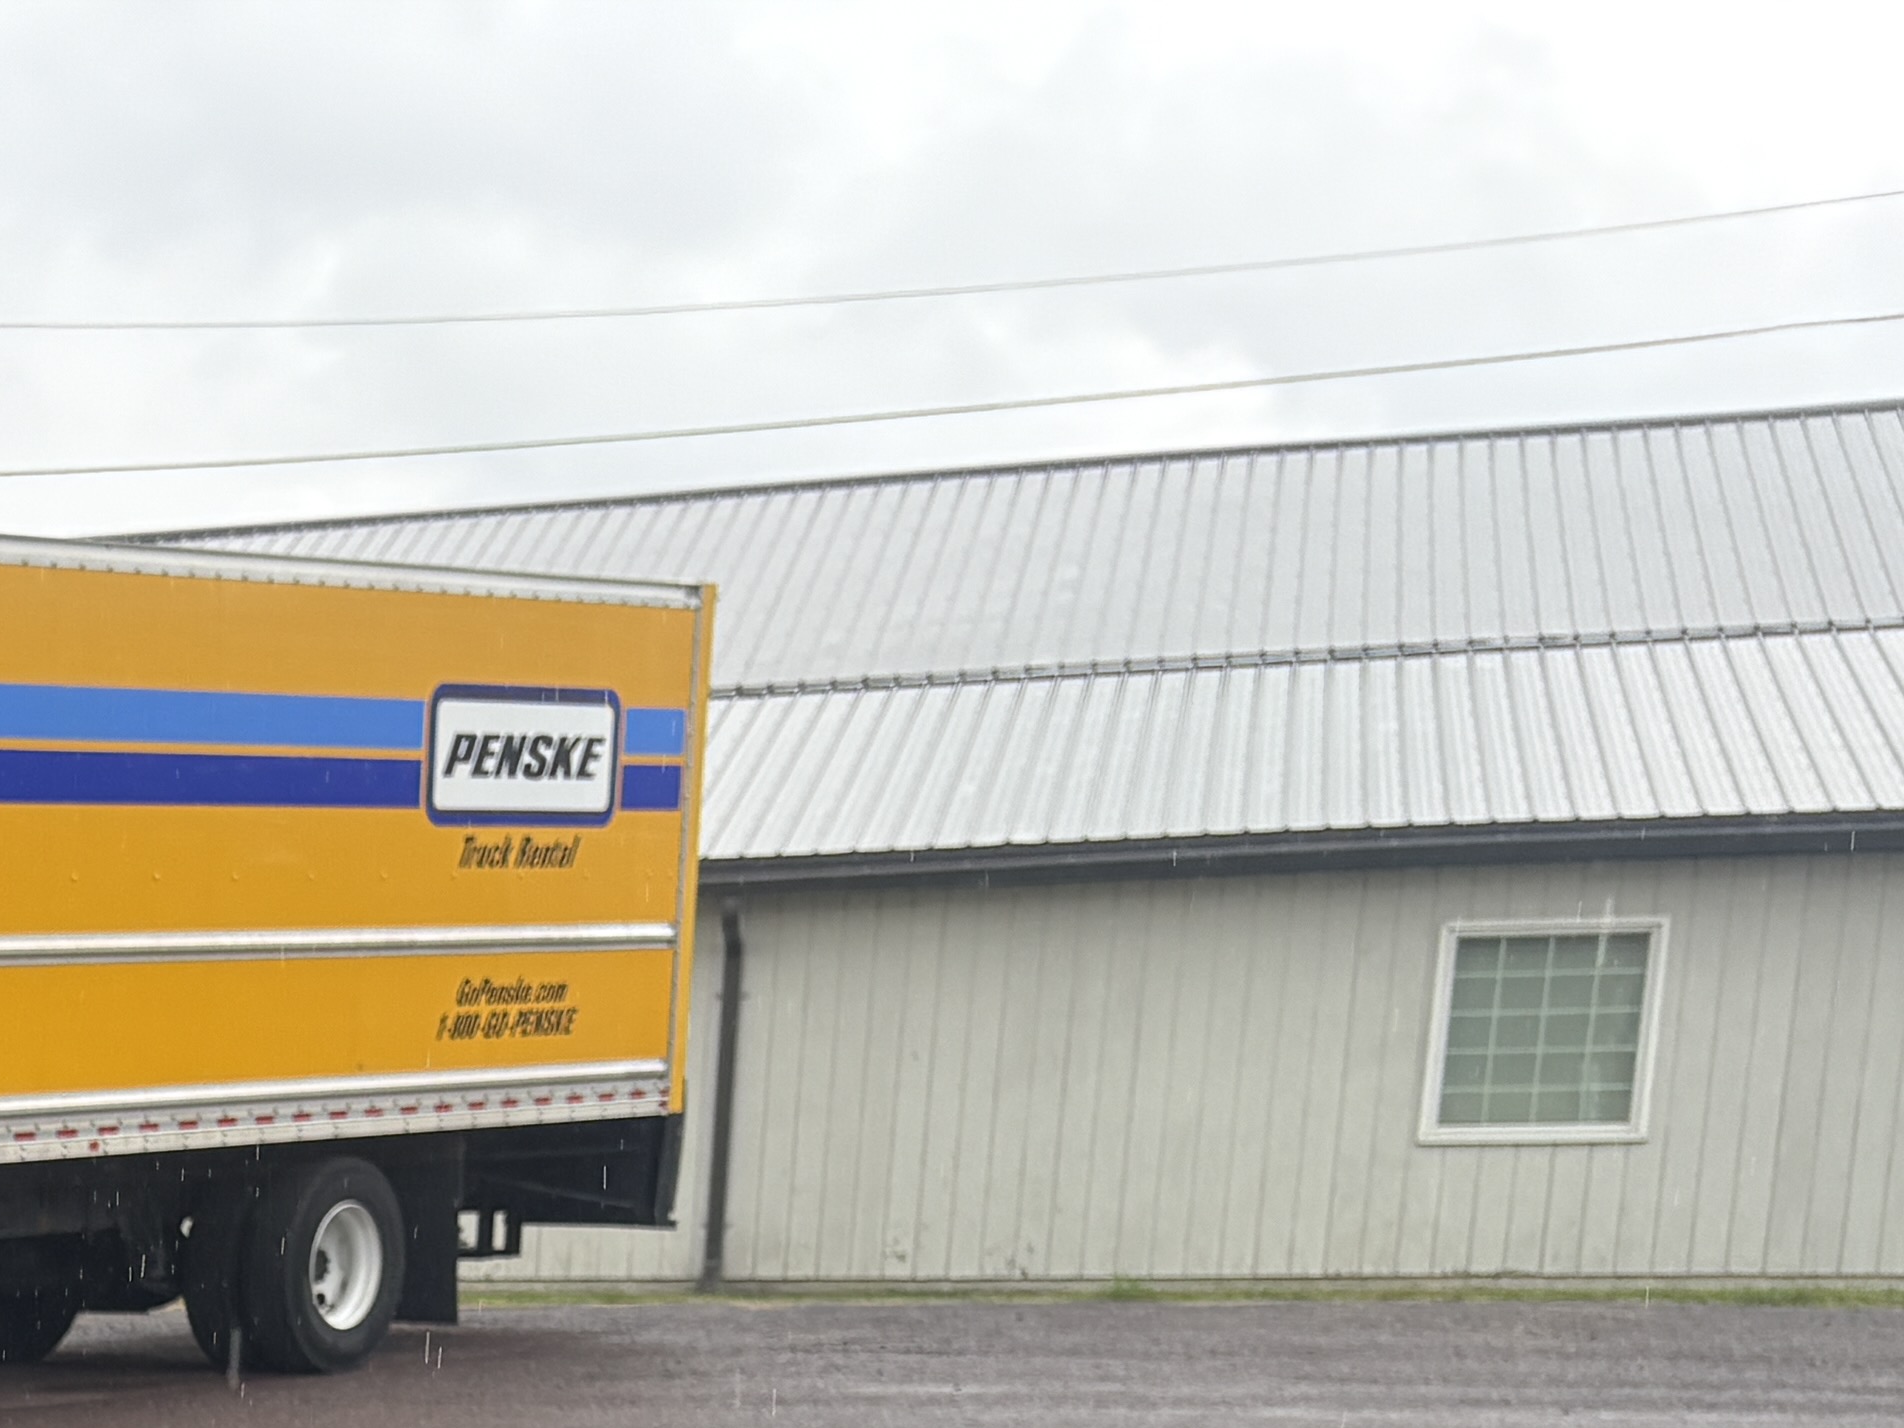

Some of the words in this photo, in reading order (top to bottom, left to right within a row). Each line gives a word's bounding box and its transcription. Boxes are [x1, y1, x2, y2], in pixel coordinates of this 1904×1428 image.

[443, 733, 606, 781] PENSKE
[459, 832, 514, 869] Truck
[514, 832, 583, 869] Rental
